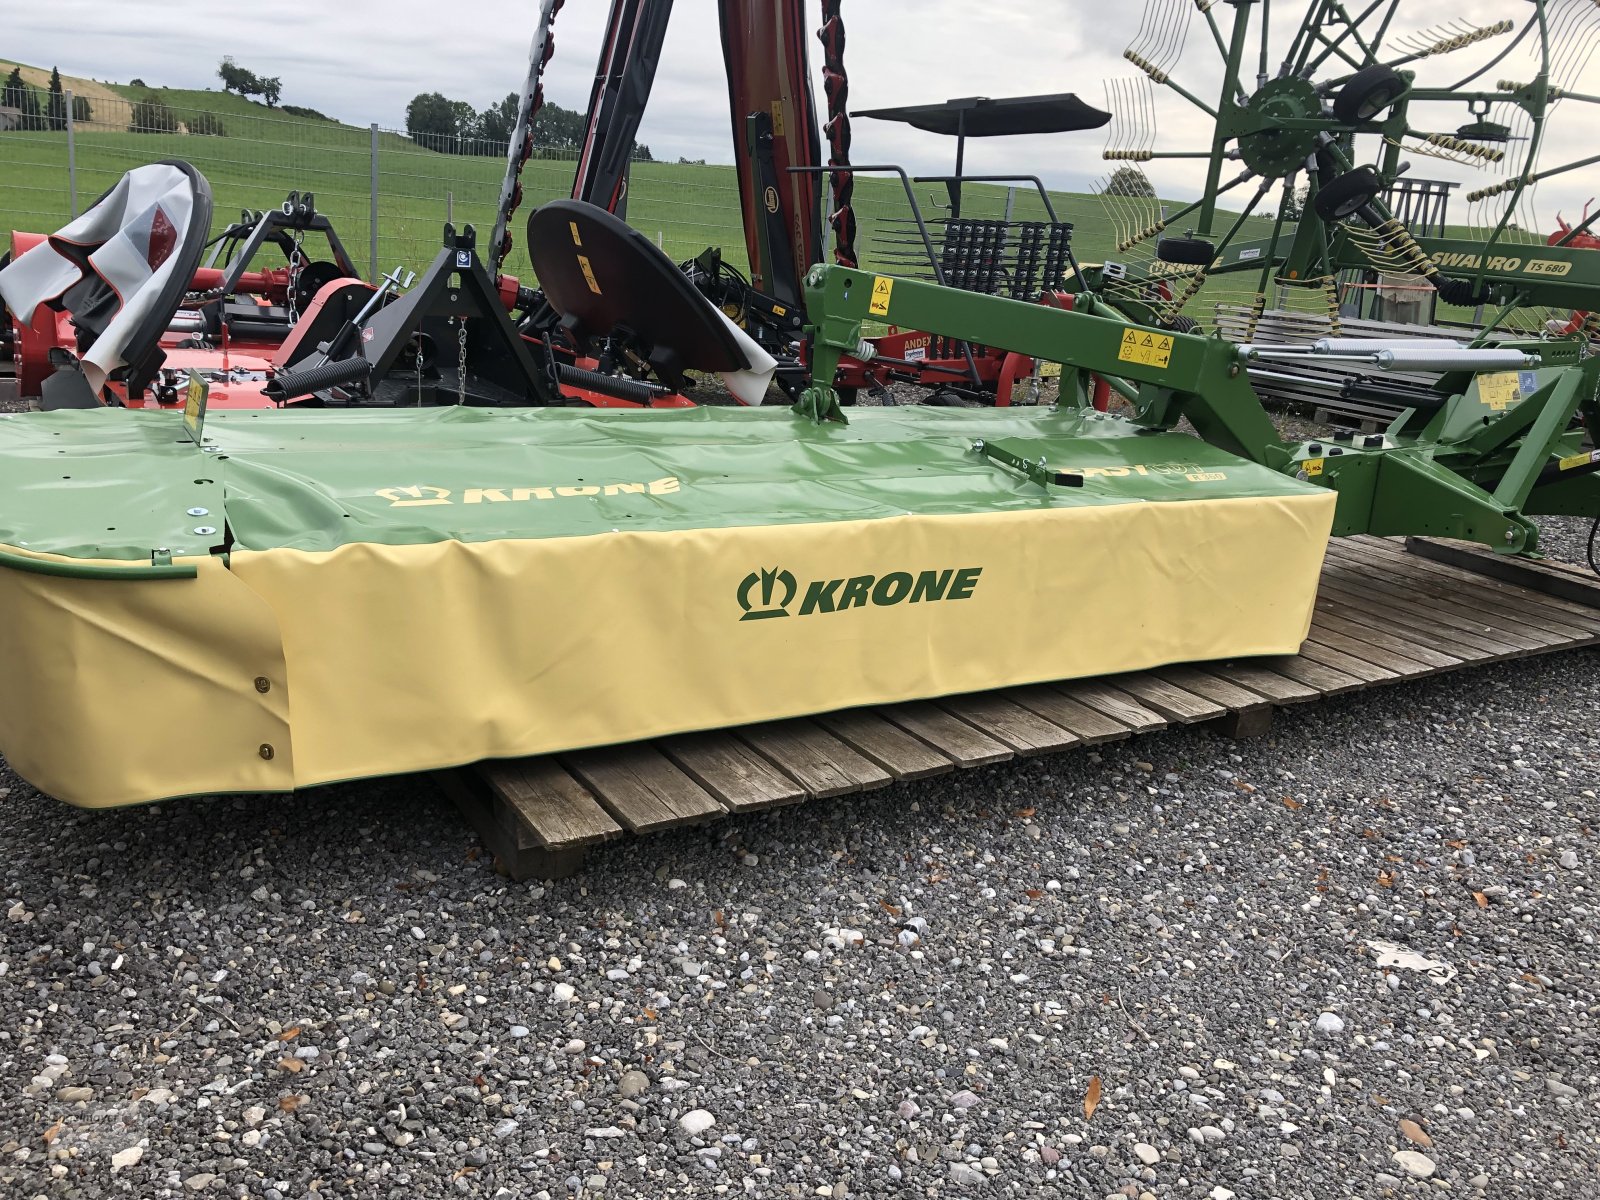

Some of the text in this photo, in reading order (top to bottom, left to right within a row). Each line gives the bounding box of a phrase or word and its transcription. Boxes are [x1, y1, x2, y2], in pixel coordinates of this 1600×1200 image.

[1431, 252, 1566, 273] SWADRO TS 680
[905, 336, 931, 350] ANDEX
[1203, 473, 1223, 481] 360
[463, 477, 681, 504] KRONE
[798, 567, 983, 616] KRONE
